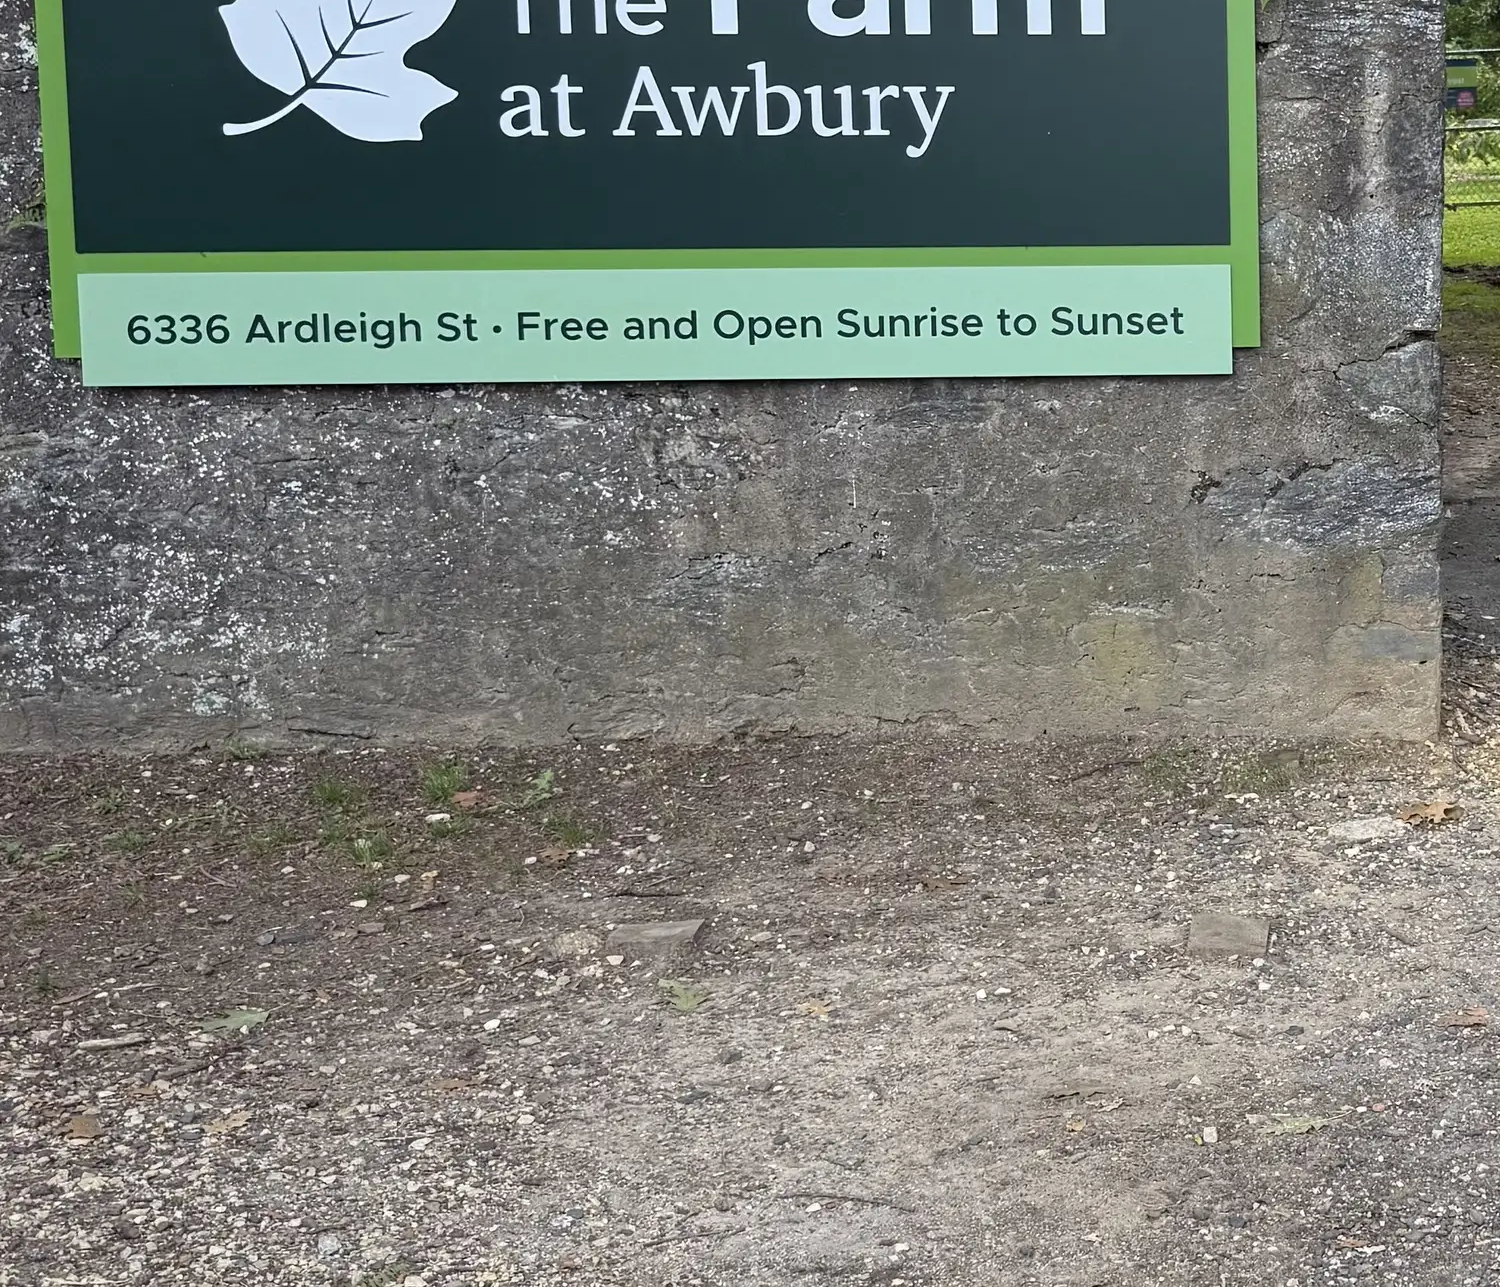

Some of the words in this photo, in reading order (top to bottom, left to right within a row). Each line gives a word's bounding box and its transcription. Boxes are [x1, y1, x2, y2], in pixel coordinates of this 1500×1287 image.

[499, 74, 586, 138] at
[612, 60, 956, 158] Awbury
[127, 313, 231, 346] 6336
[244, 311, 422, 350] Ardleigh
[436, 311, 479, 343] St
[517, 311, 609, 341] Free
[623, 309, 698, 341] and
[713, 309, 823, 346] Open
[836, 306, 984, 339] Sunrise
[996, 308, 1037, 337] to
[1050, 306, 1185, 336] Sunset
